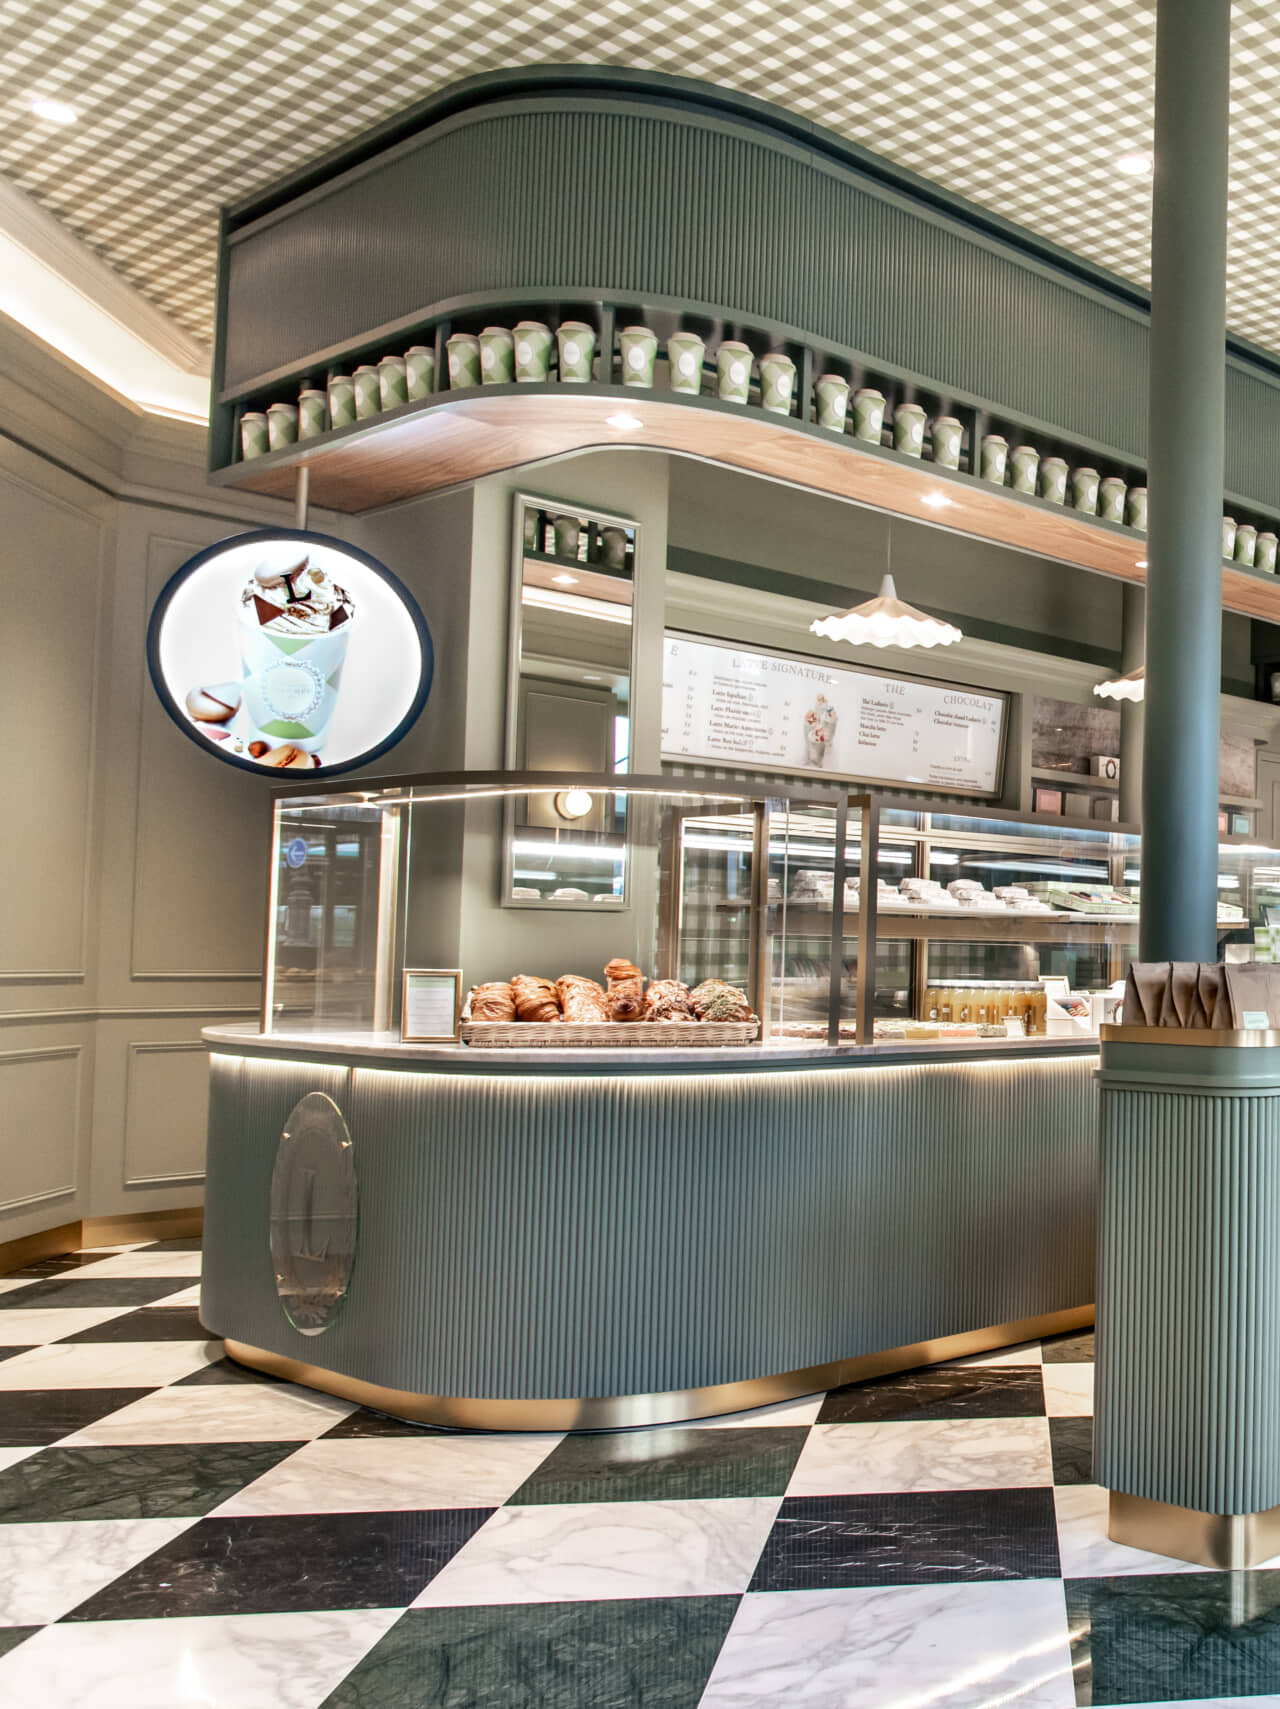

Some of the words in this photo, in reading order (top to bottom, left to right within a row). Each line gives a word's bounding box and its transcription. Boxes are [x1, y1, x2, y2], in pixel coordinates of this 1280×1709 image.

[279, 573, 312, 604] L
[771, 661, 833, 684] SIGNATURE
[943, 695, 994, 712] CHOCOLAT
